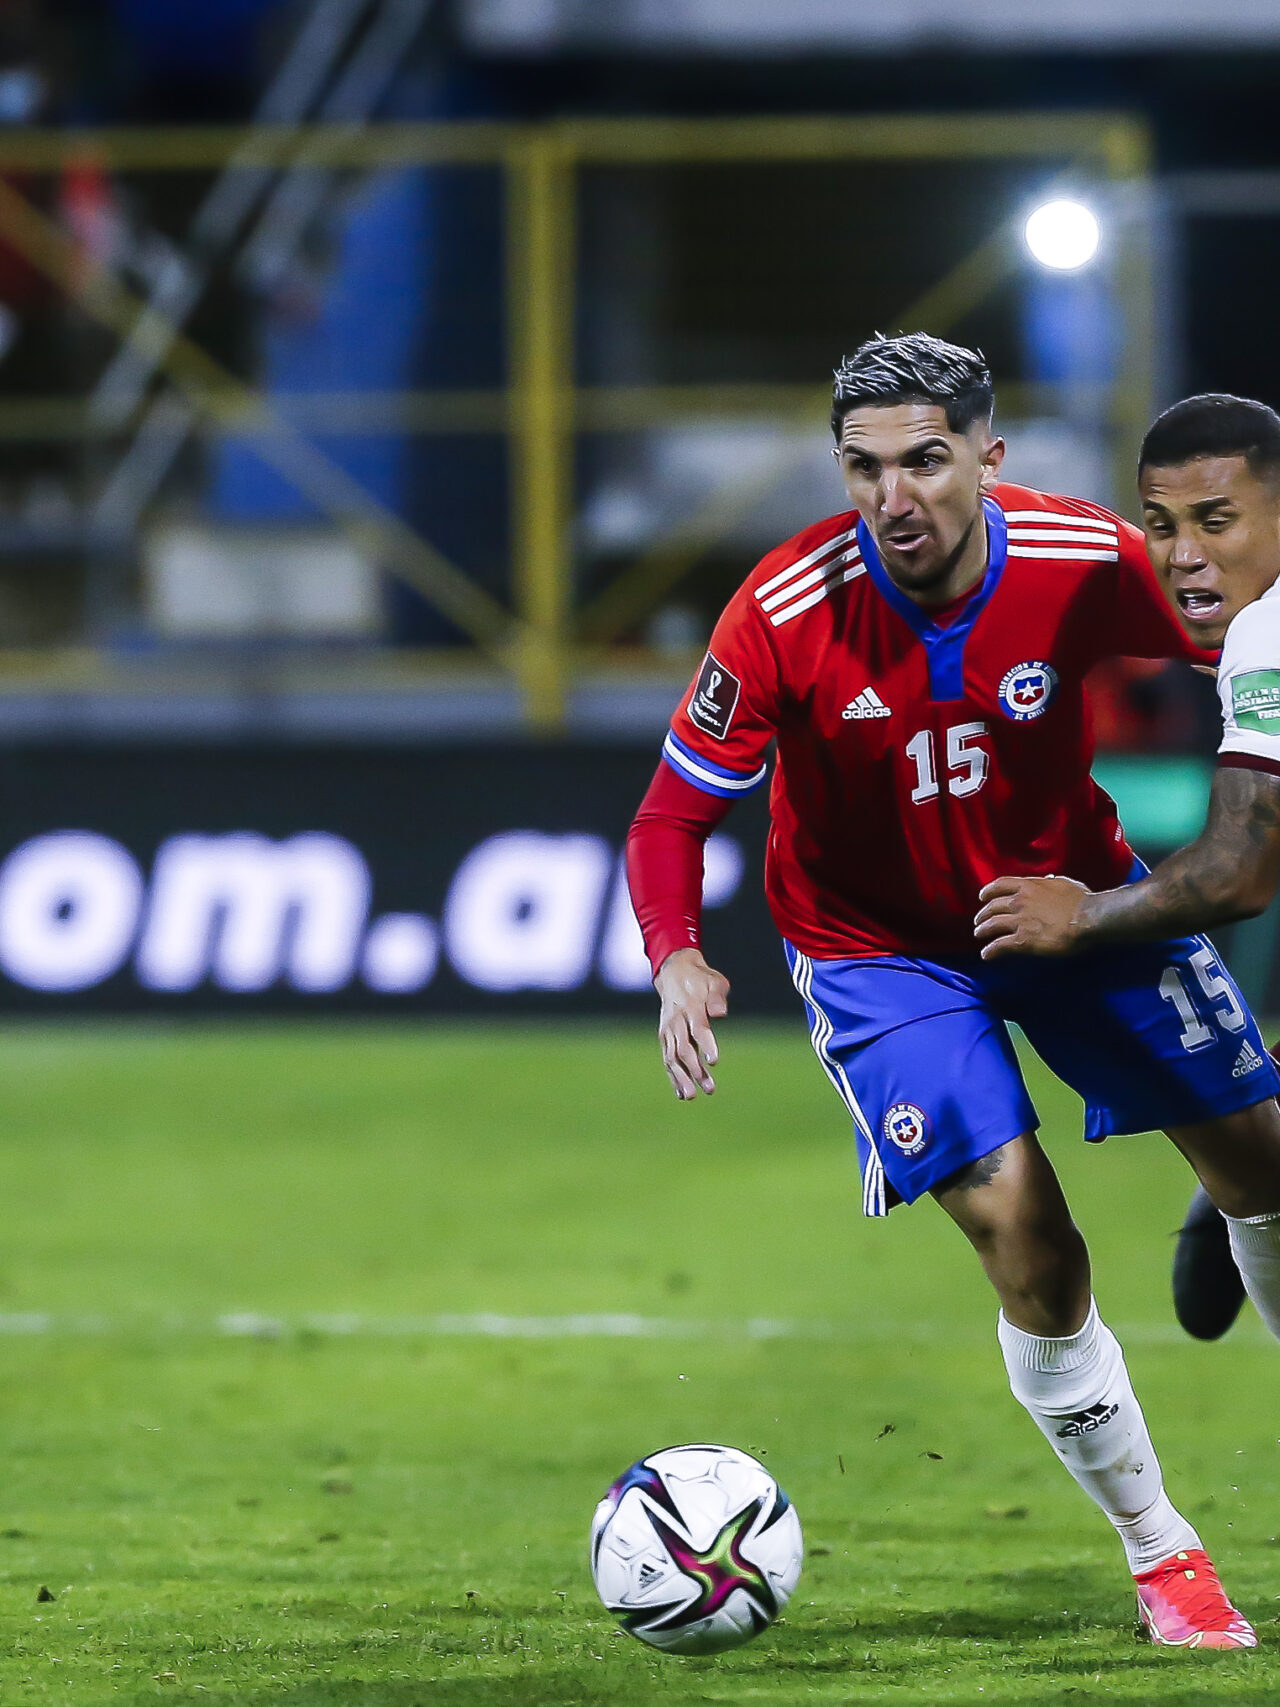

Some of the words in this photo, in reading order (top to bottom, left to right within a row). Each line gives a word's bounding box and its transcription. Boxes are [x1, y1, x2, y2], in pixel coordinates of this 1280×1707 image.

[841, 706, 892, 720] adidas
[905, 721, 990, 806] 15
[1158, 947, 1248, 1053] 15
[1231, 1055, 1264, 1078] adidas
